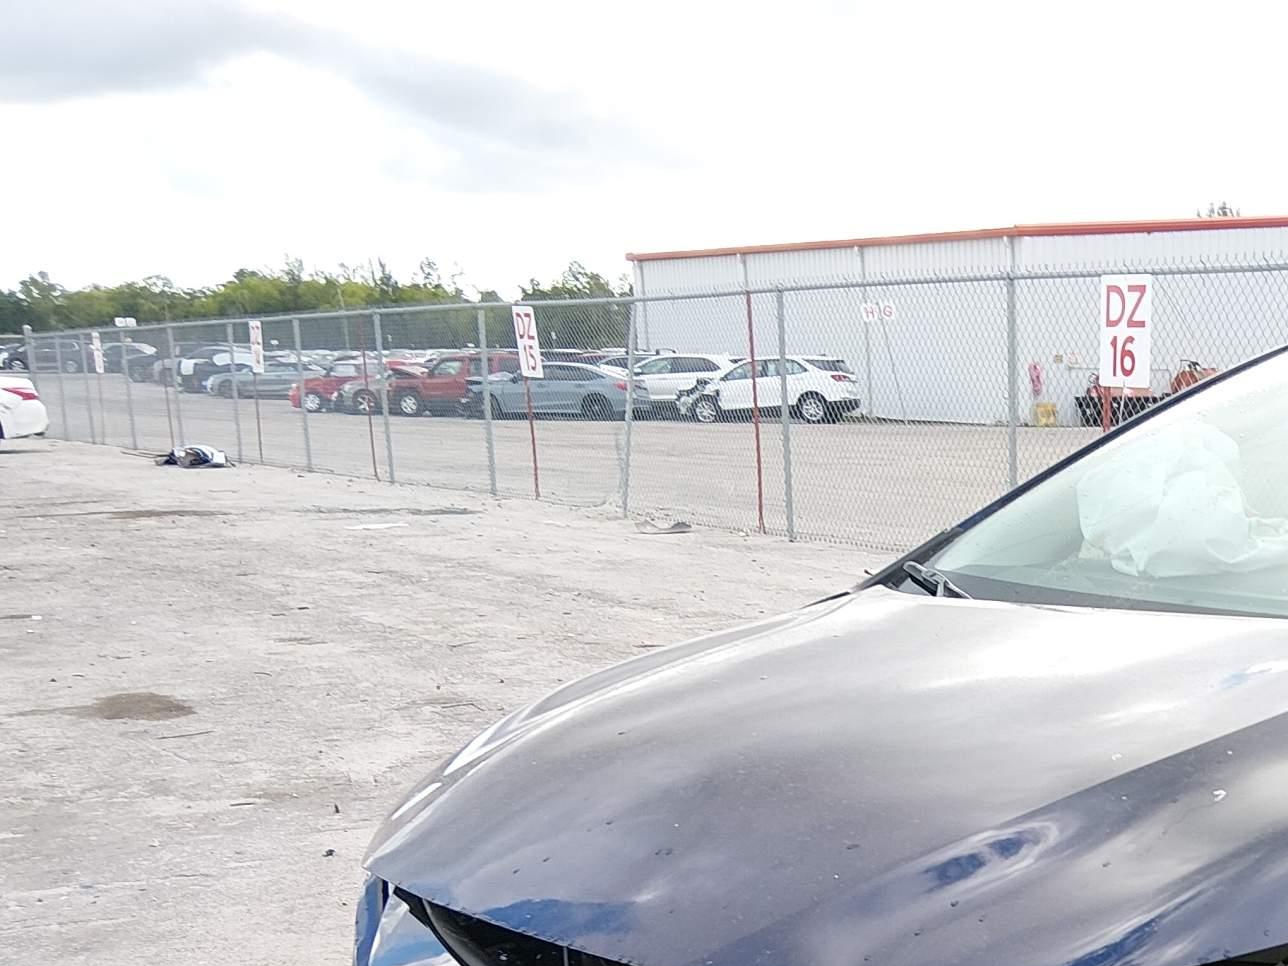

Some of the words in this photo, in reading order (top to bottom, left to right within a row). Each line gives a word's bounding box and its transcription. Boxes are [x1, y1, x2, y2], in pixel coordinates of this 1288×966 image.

[1106, 285, 1146, 328] DZ
[515, 312, 535, 340] DZ
[523, 344, 537, 371] 15
[1110, 335, 1136, 377] 16
